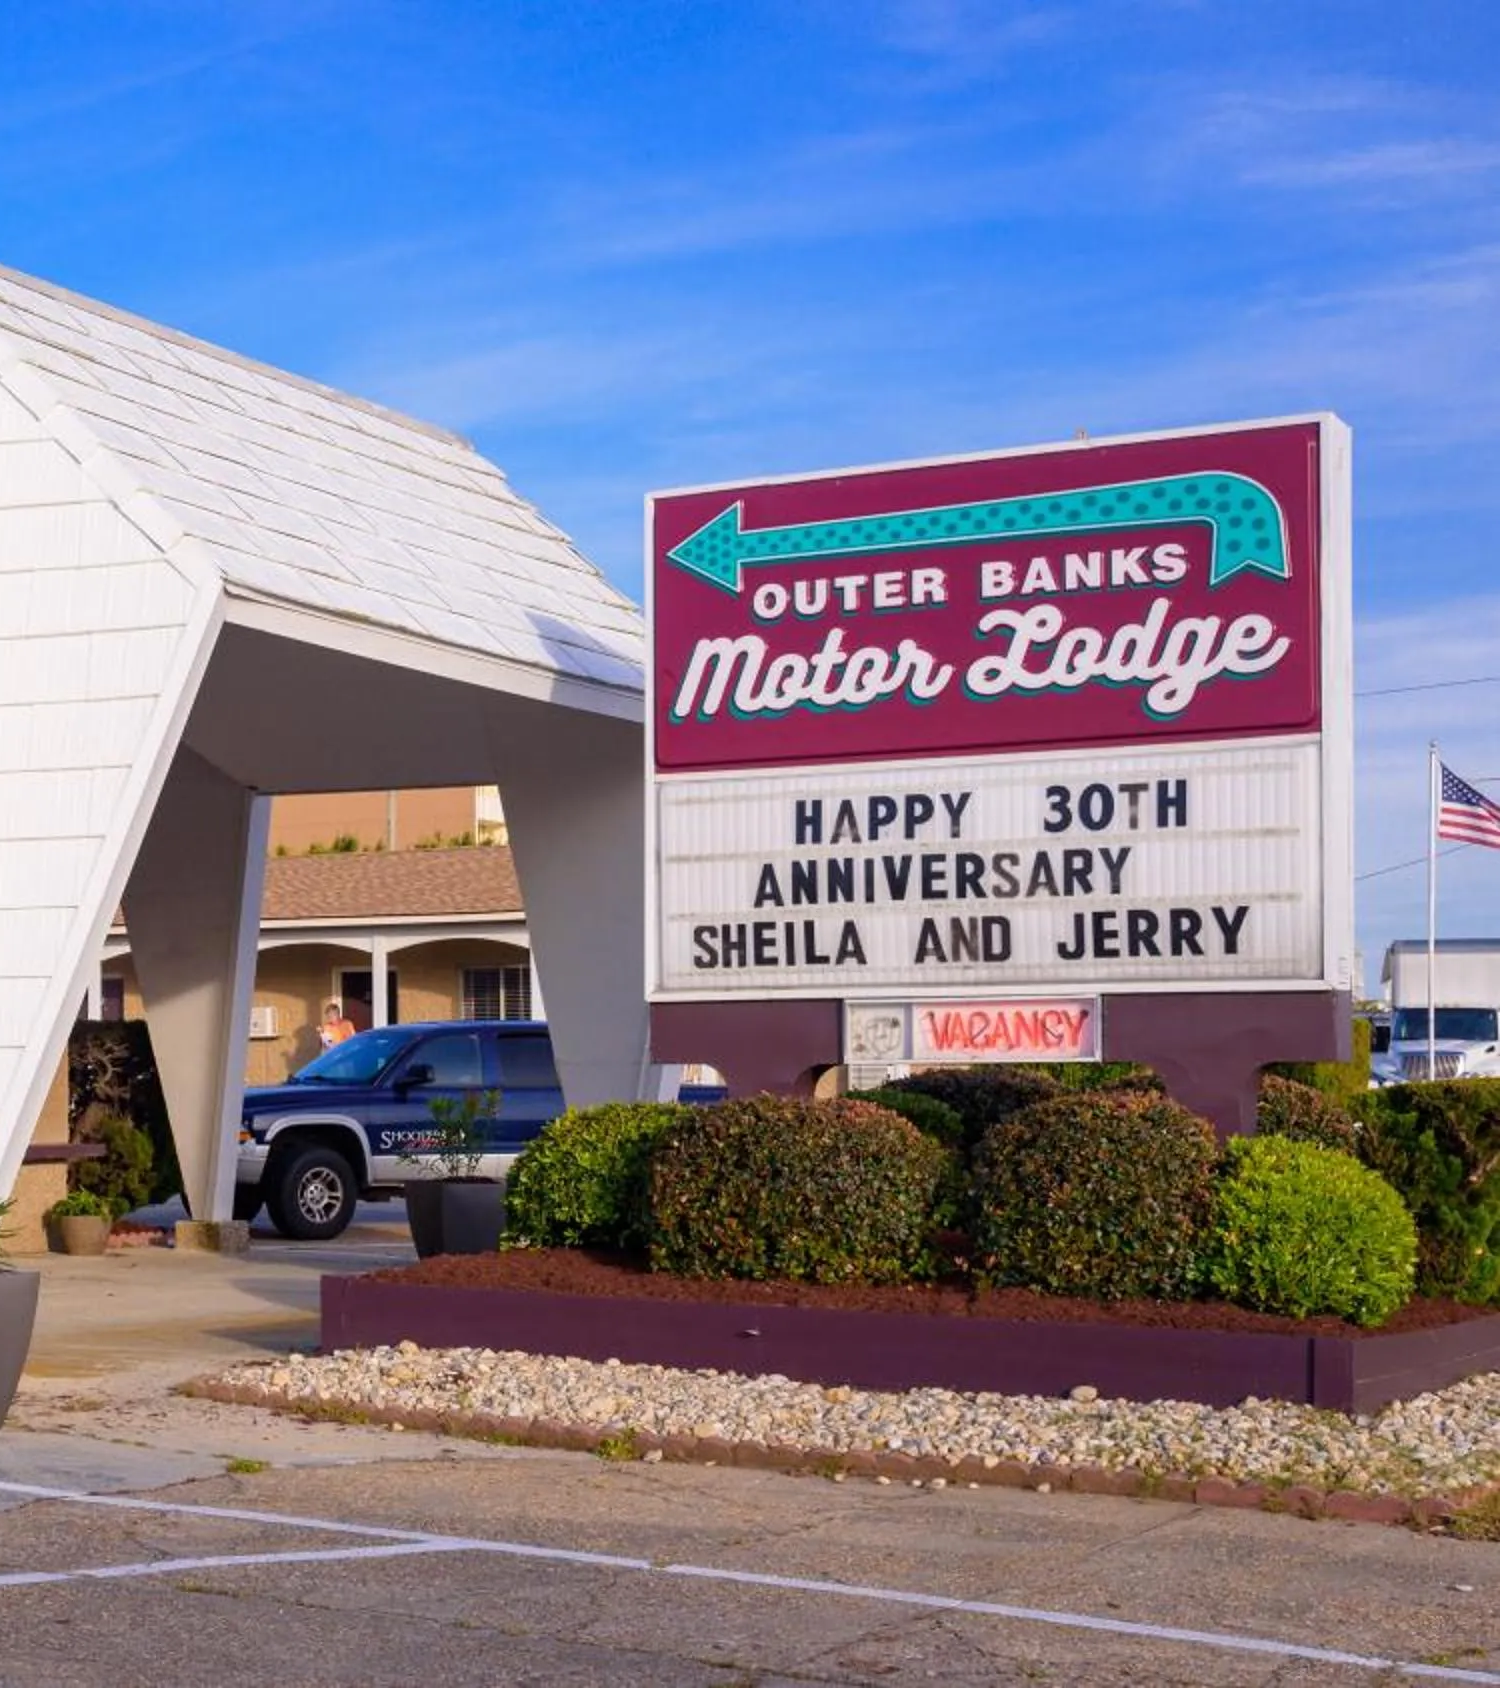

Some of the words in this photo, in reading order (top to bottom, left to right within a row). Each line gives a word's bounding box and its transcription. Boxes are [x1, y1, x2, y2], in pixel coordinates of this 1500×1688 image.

[752, 568, 946, 619] OUTER
[980, 544, 1188, 598] BANKS
[671, 627, 954, 720] Motor
[966, 598, 1291, 717] Lodge
[795, 791, 973, 846] HAPPY
[1043, 778, 1188, 834] 30TH
[753, 846, 1132, 909] ANNIVERSARY
[693, 919, 868, 970] SHEILA
[913, 915, 1013, 965] AND
[1056, 905, 1251, 961] JERRY
[925, 1009, 1091, 1051] VACANCY
